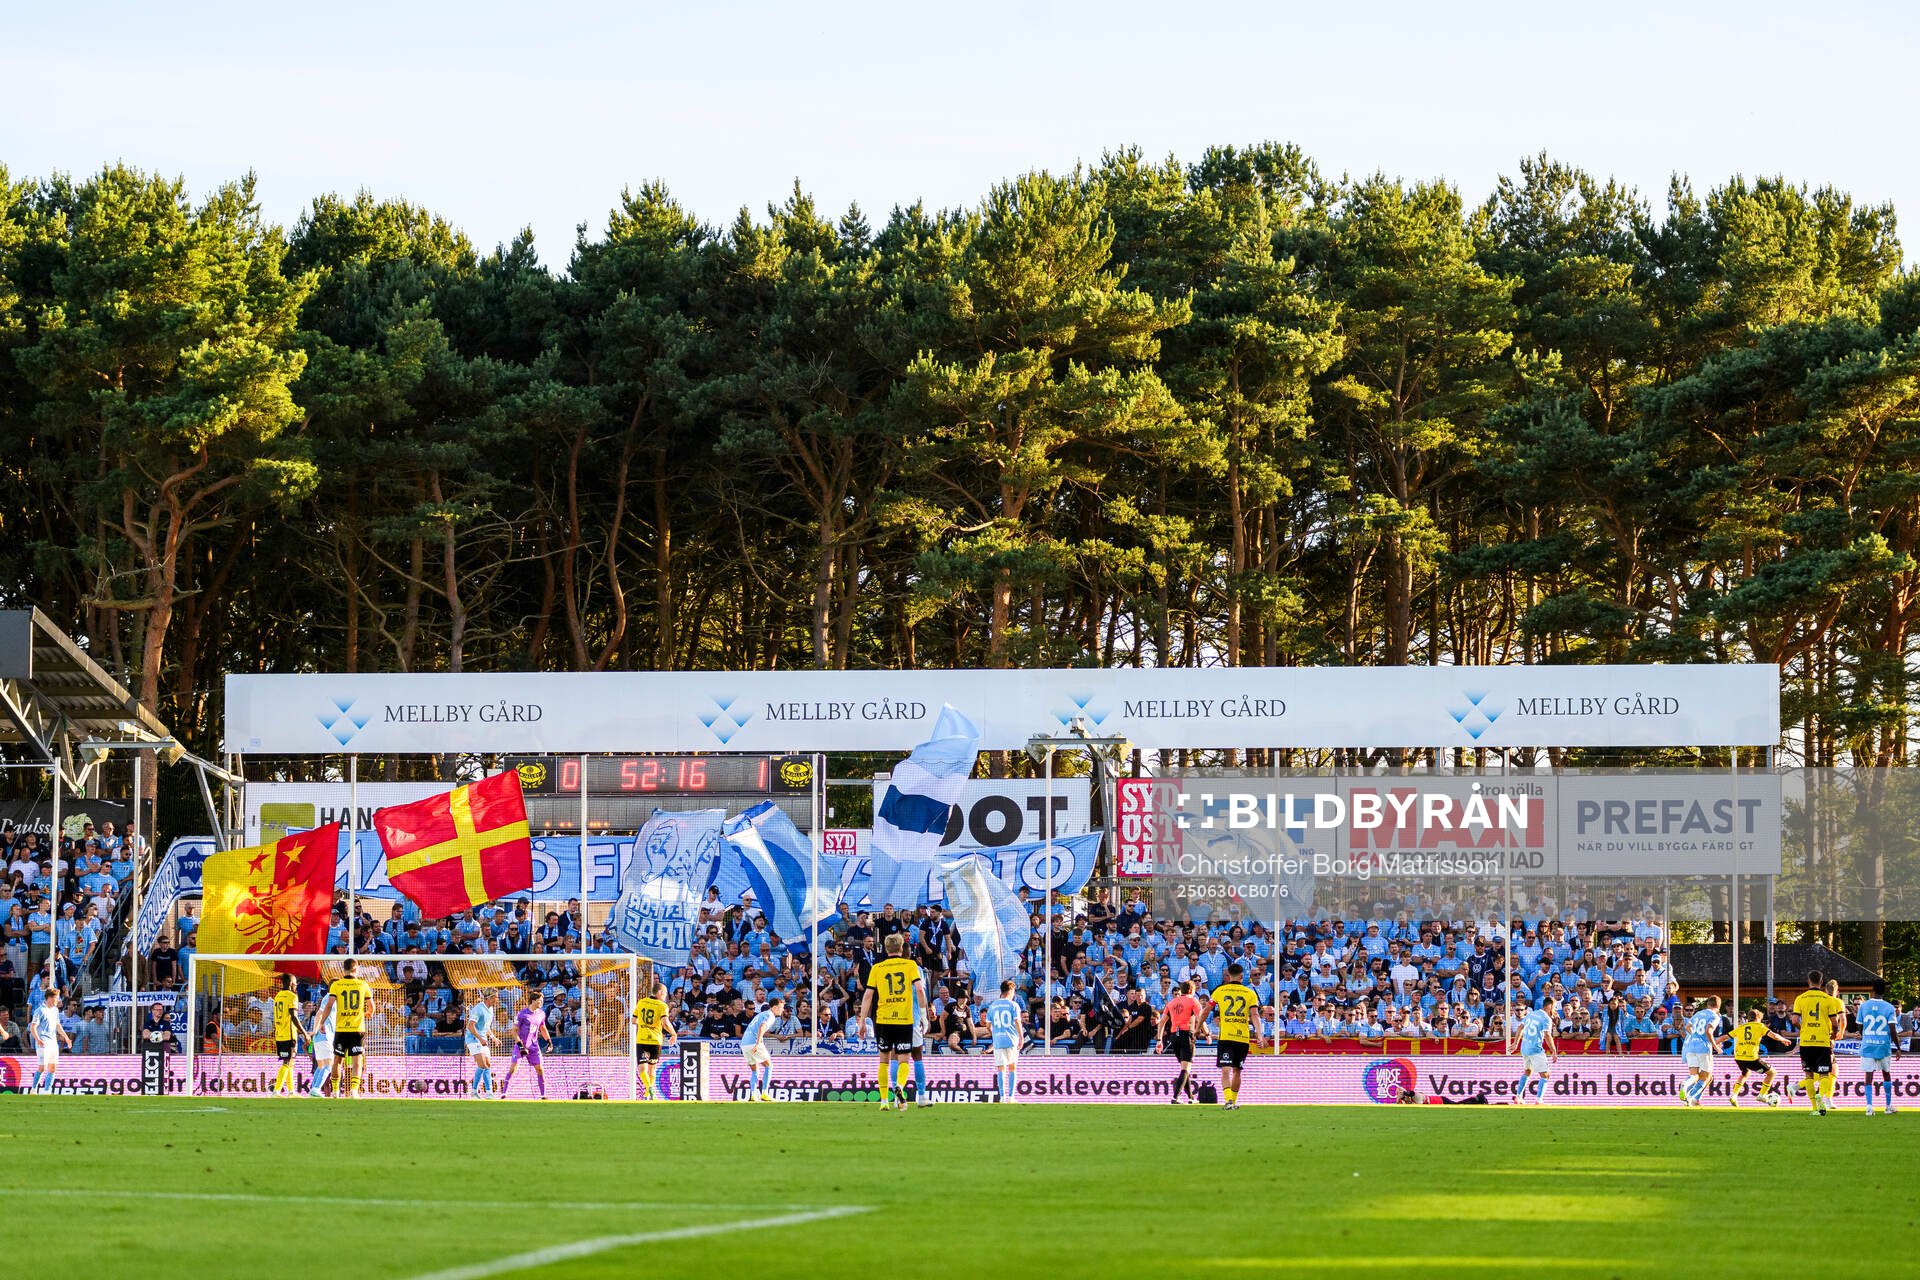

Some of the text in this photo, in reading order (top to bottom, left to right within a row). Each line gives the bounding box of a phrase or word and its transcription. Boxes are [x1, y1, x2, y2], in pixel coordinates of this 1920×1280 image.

[384, 699, 543, 723] MELLBY GÅRD
[765, 697, 926, 721] MELLBY GÅRD
[1123, 694, 1286, 718] MELLBY GÅRD
[1517, 692, 1680, 716] MELLBY GÅRD
[562, 761, 579, 789] 0
[620, 761, 706, 789] 52:16
[1122, 783, 1181, 813] SYD
[1475, 783, 1544, 797] Broölla
[0, 817, 52, 836] Paulss
[320, 807, 384, 830] HAN
[1349, 787, 1545, 849] MAXI
[1577, 799, 1762, 835] PREFAST
[825, 831, 856, 850] SYD
[1577, 840, 1755, 851] NÄR DU VILL BYGGA FÄRDGT
[884, 971, 906, 996] 13
[341, 989, 360, 1010] 10
[1223, 995, 1247, 1018] 22
[641, 1008, 655, 1025] 18
[993, 1010, 1012, 1029] 40
[1808, 1002, 1820, 1021] 4
[1744, 1026, 1753, 1041] 6
[1862, 1014, 1888, 1036] 22
[145, 1050, 159, 1096] ELECT
[1553, 1072, 1599, 1095] din
[1607, 1073, 1686, 1096] lokal
[51, 1078, 142, 1096] arsego
[735, 1089, 819, 1102] UIBET
